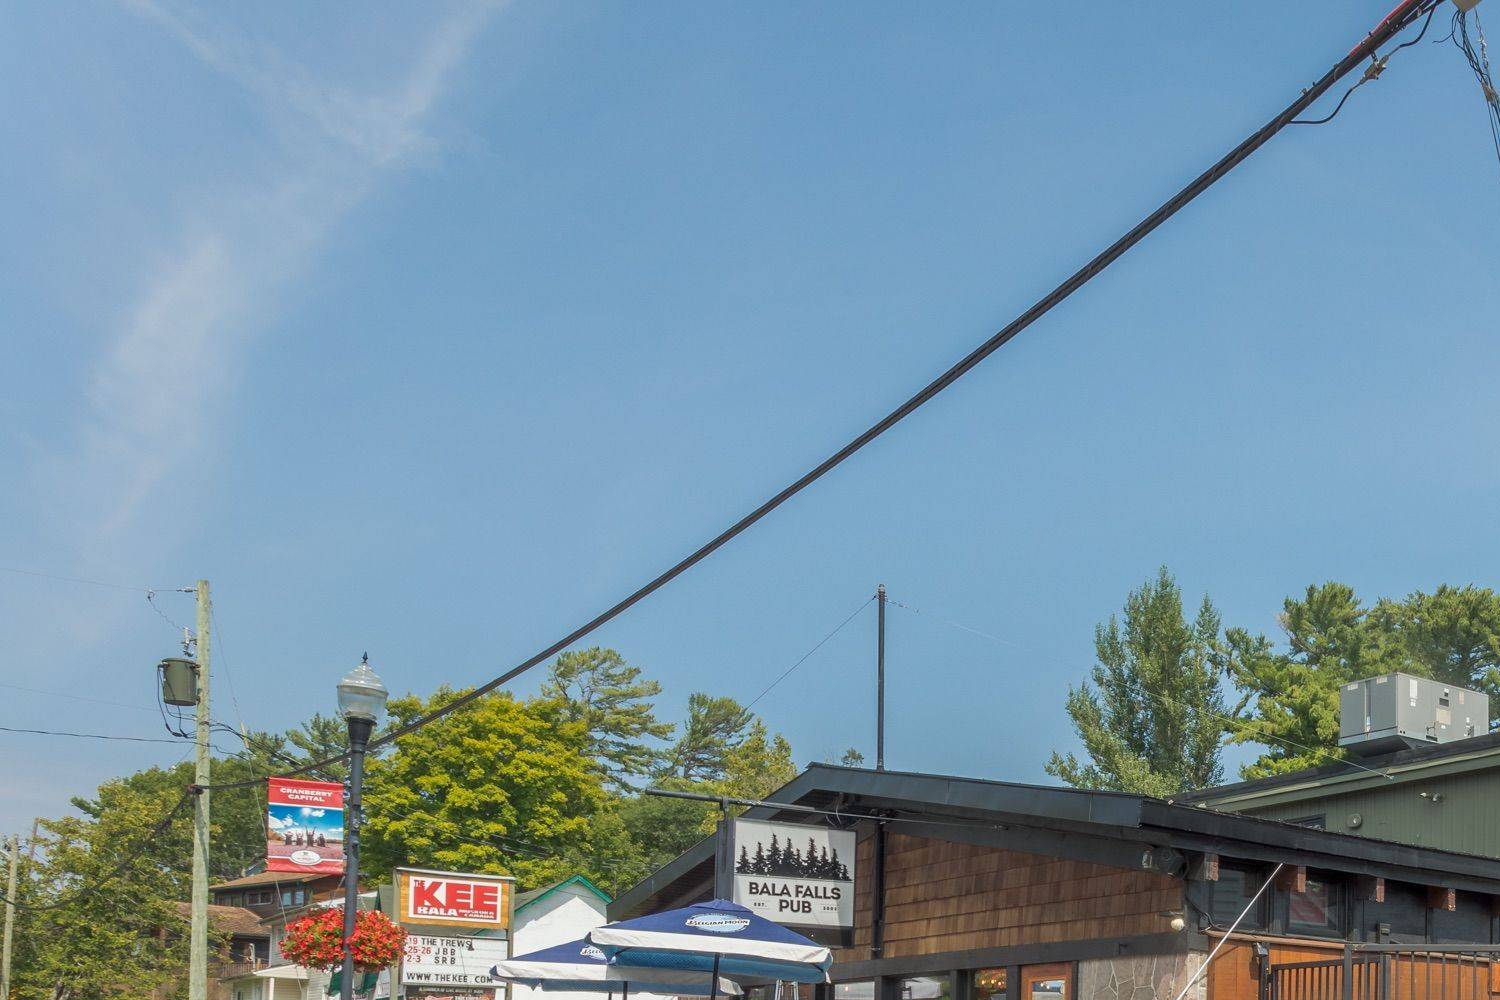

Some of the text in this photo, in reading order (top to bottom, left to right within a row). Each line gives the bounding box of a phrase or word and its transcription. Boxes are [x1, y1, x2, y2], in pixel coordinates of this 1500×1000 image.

[280, 787, 333, 797] CRANBERRY
[288, 794, 326, 802] CAPITAL
[749, 881, 841, 900] BALA FALLS
[414, 881, 499, 911] KEE
[417, 906, 458, 916] BALA
[779, 899, 812, 914] PUB
[421, 938, 437, 946] THE
[440, 939, 472, 948] TREWS
[407, 946, 431, 955] 25-26
[407, 955, 421, 963] 2-3
